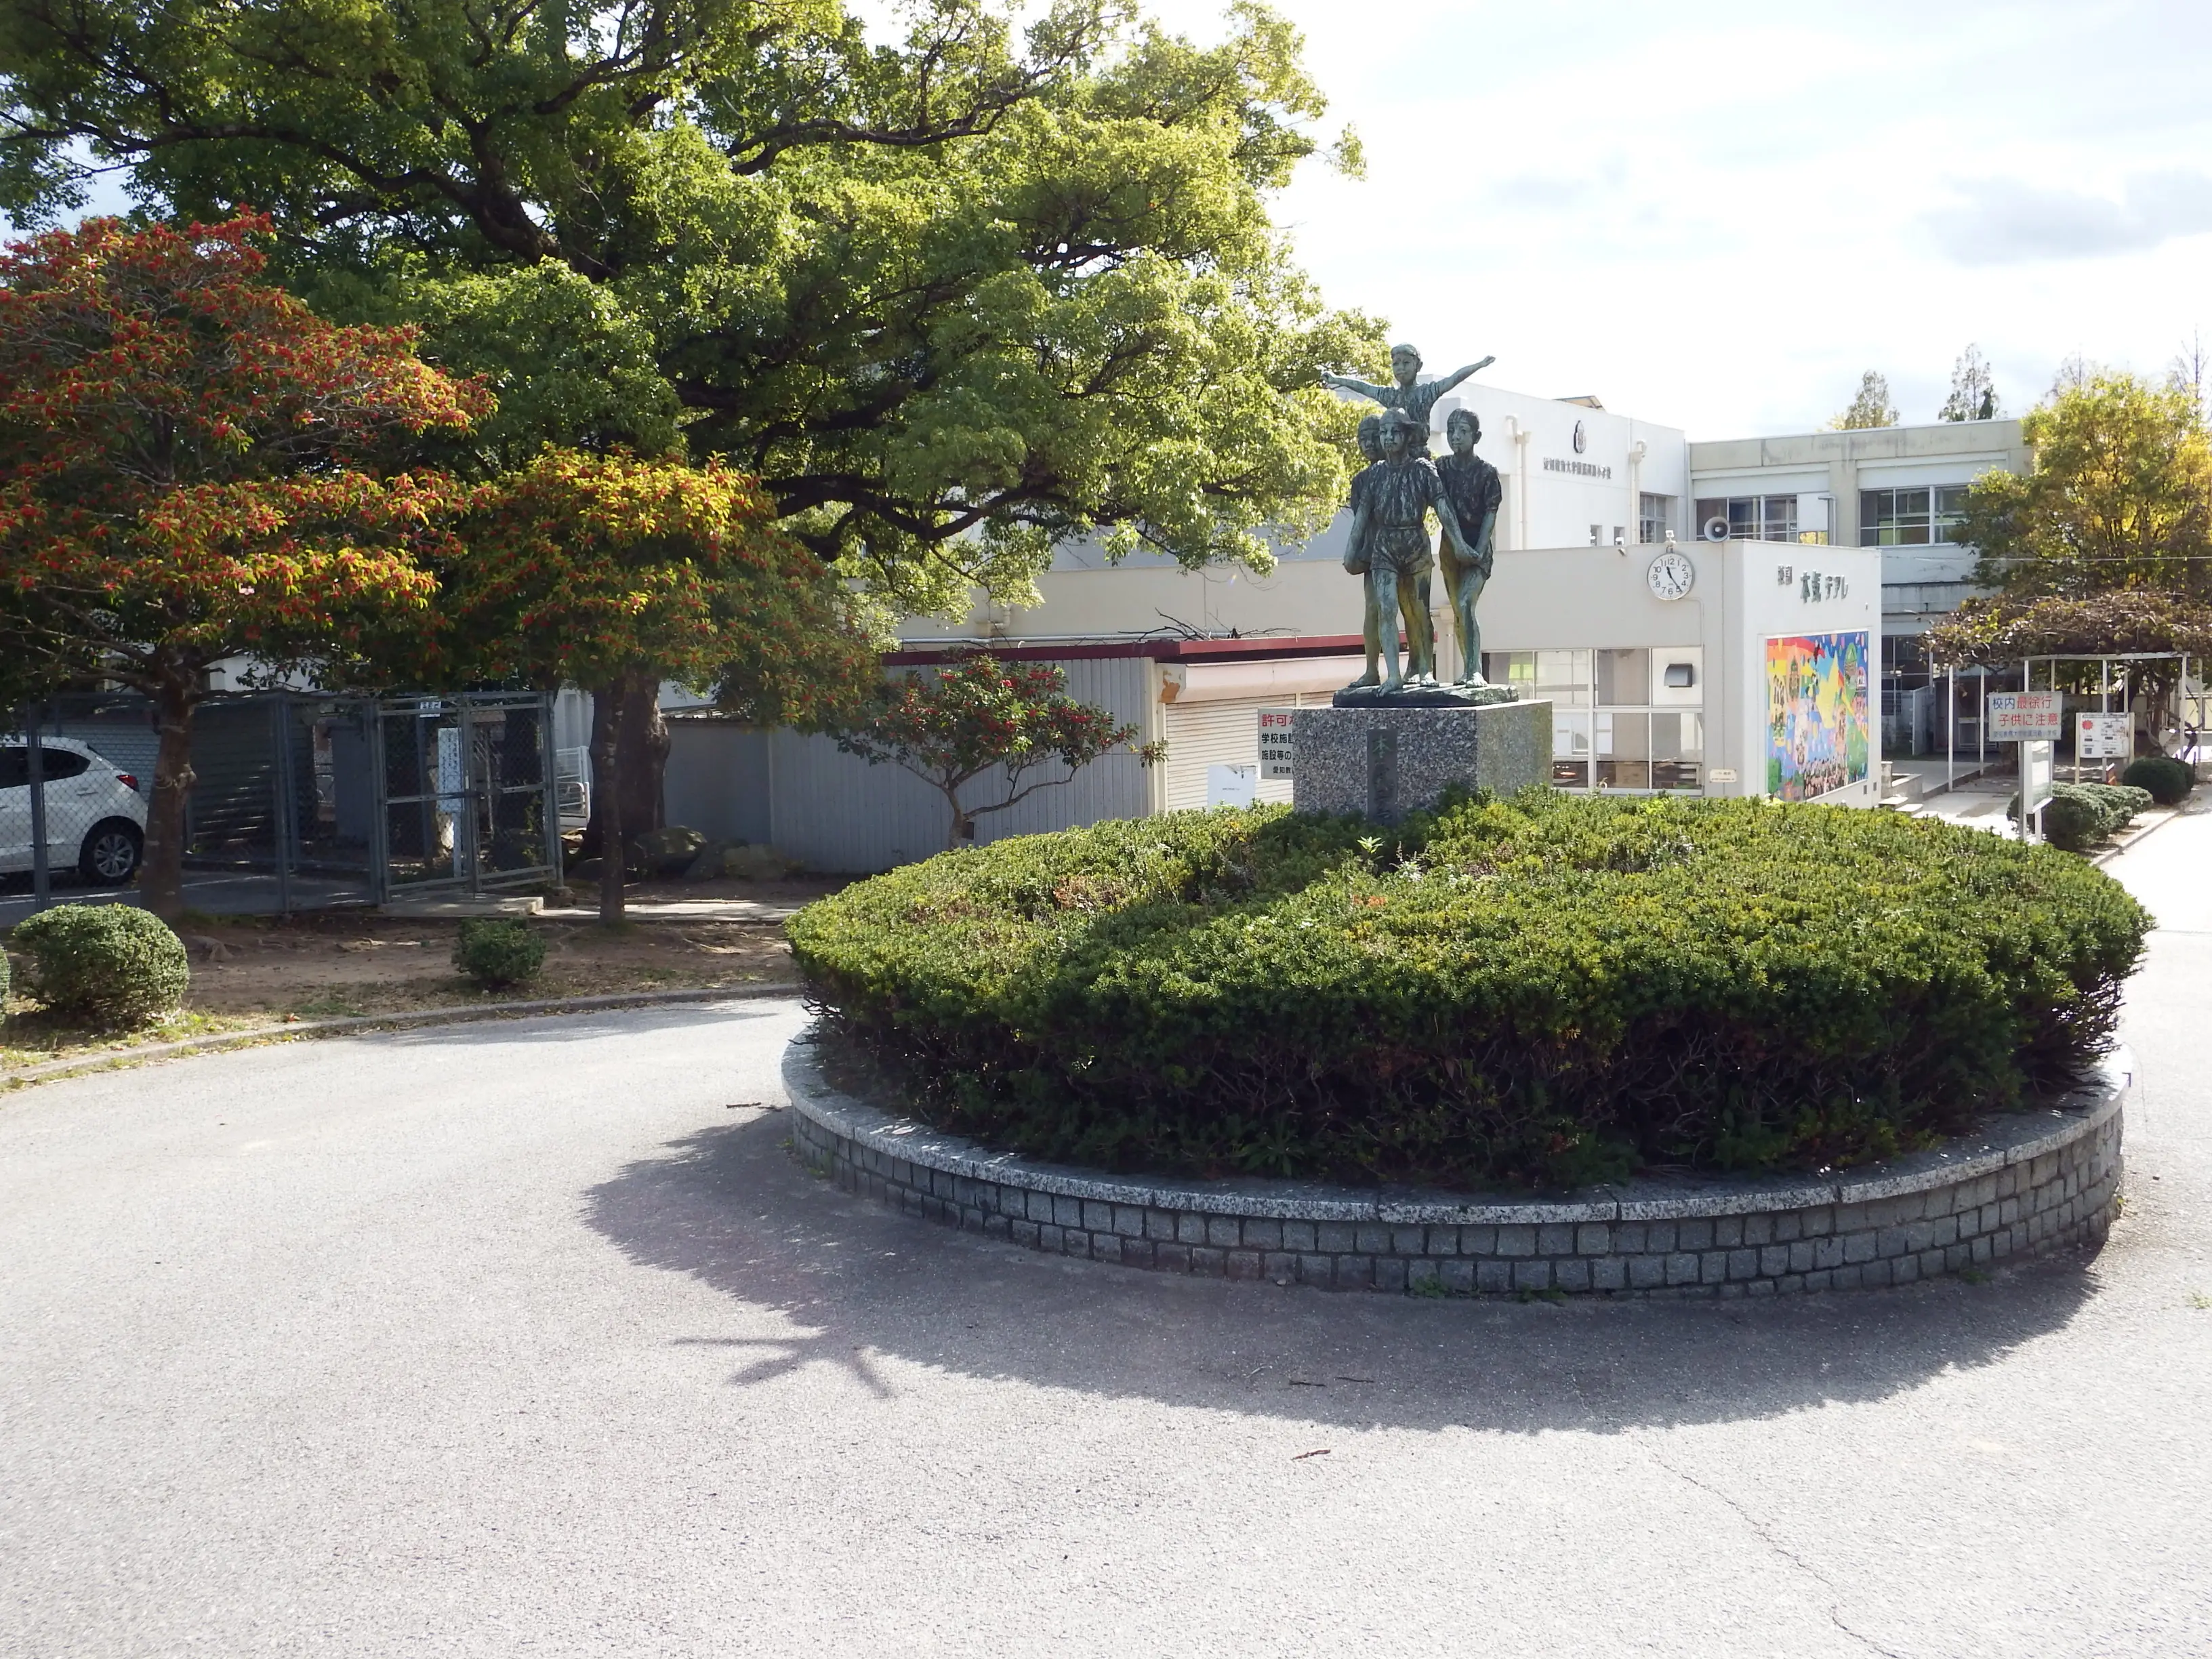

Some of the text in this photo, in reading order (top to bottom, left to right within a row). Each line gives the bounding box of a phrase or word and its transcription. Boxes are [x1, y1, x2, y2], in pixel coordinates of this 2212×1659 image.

[1992, 695, 2052, 710] 校内最徐行
[1999, 712, 2058, 726] 子供に注意
[1273, 766, 1293, 774] 愛知教
